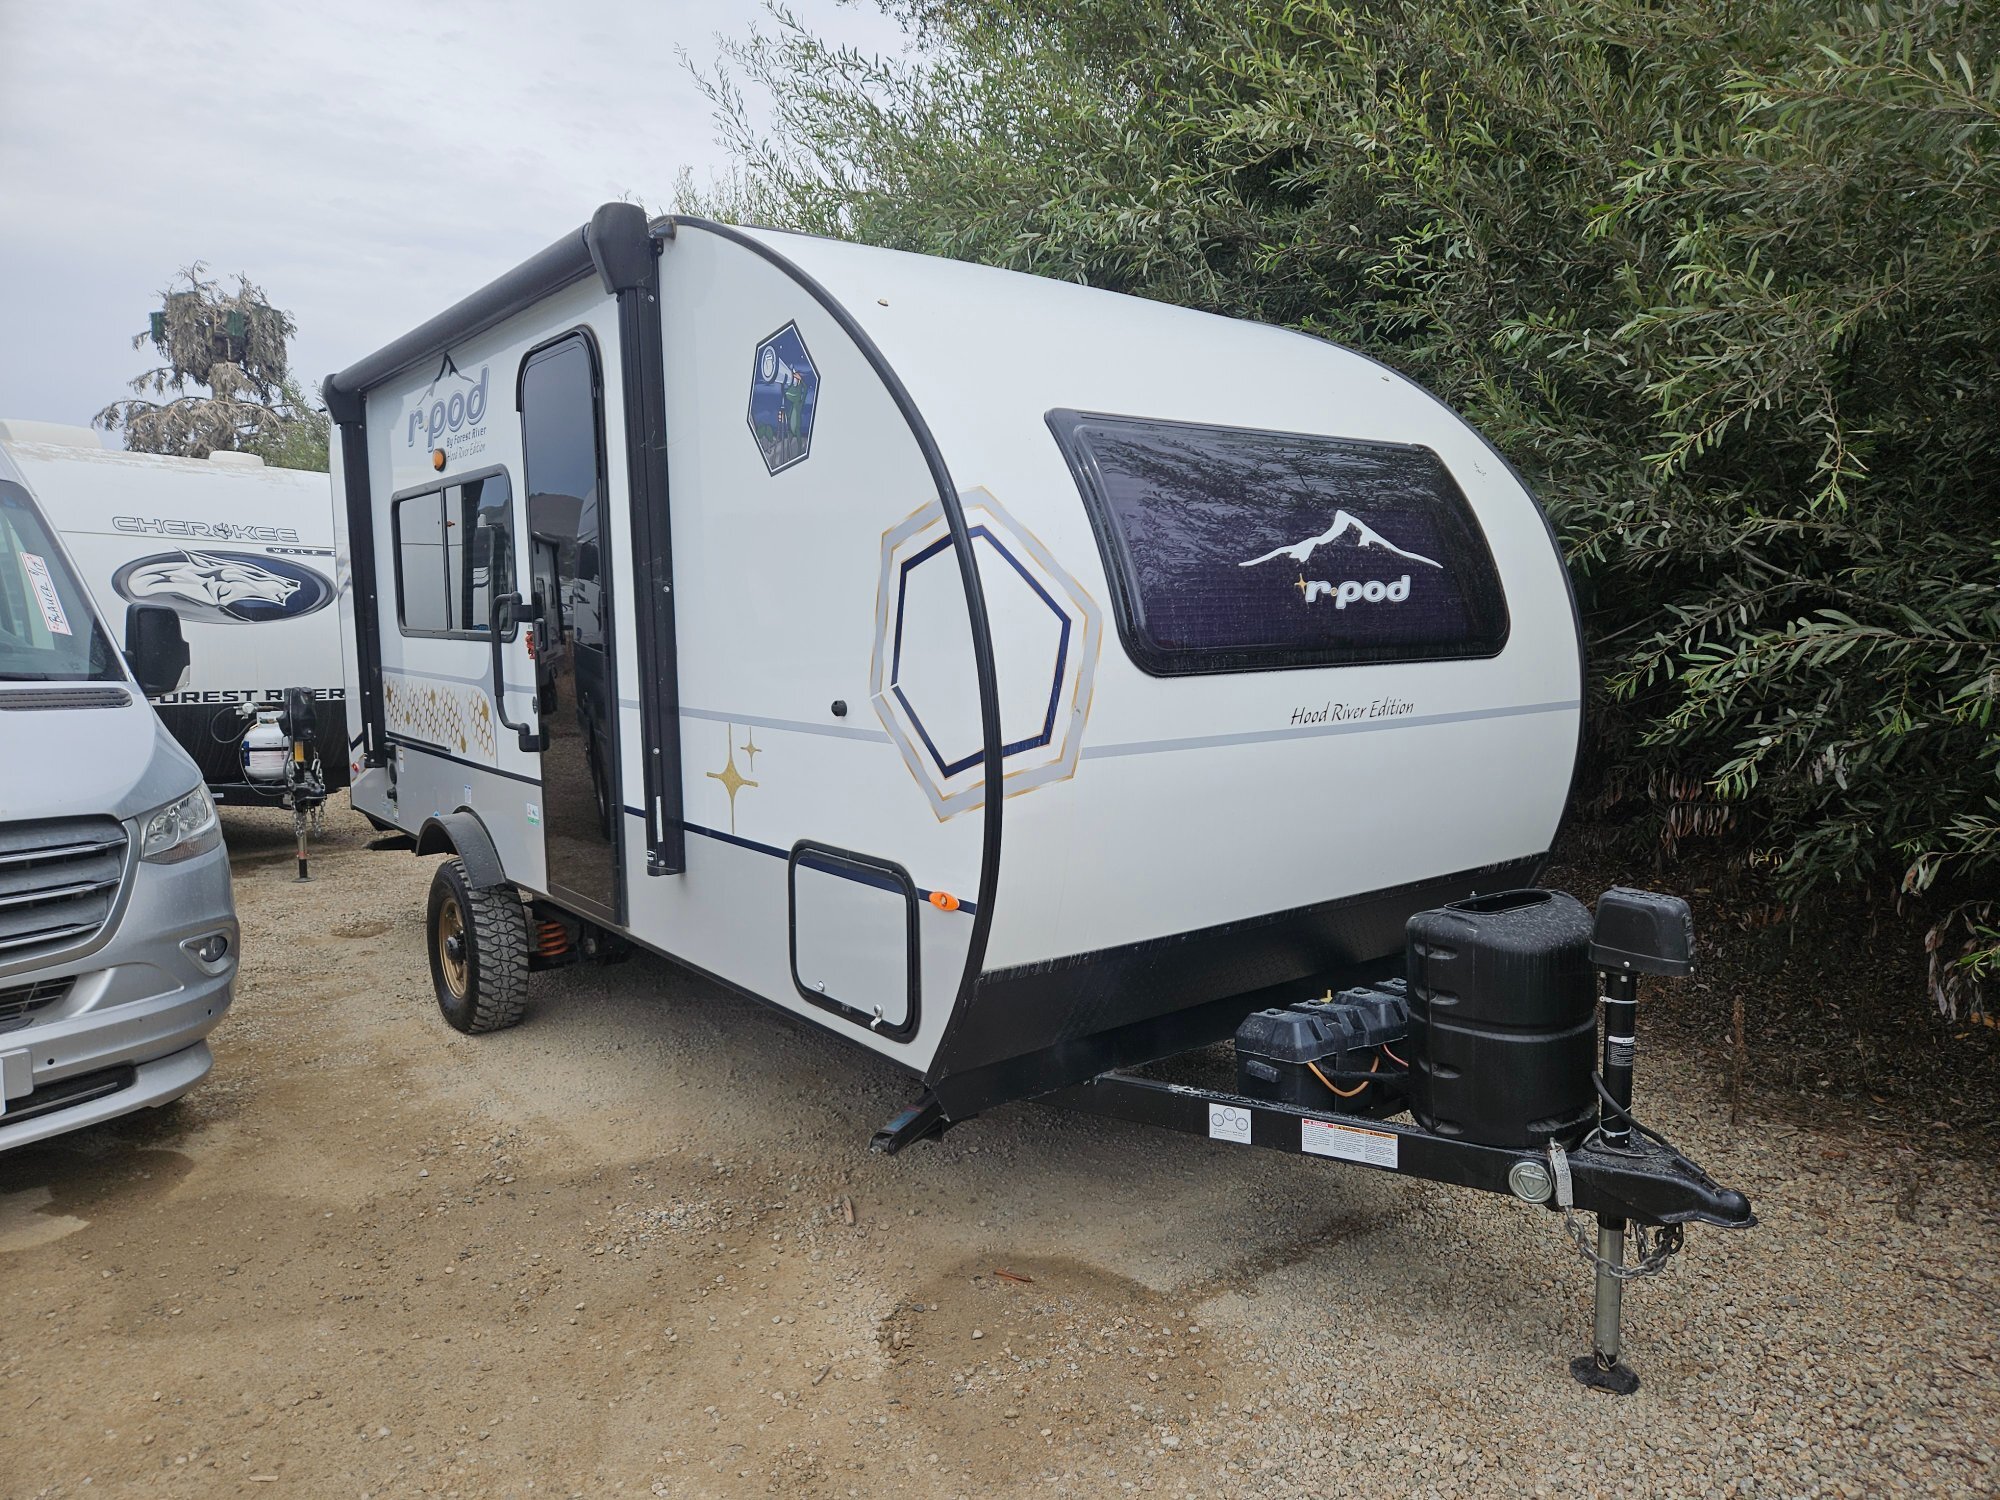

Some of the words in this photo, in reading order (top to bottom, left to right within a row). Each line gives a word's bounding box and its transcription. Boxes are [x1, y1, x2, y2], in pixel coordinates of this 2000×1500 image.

[446, 437, 454, 449] By
[454, 431, 471, 445] Forest
[472, 426, 487, 439] River
[272, 547, 318, 555] WOLF
[147, 689, 258, 704] OREST
[264, 688, 345, 701] RER
[1290, 701, 1331, 726] Hood
[1331, 703, 1367, 722] River
[1369, 696, 1415, 718] Edition
